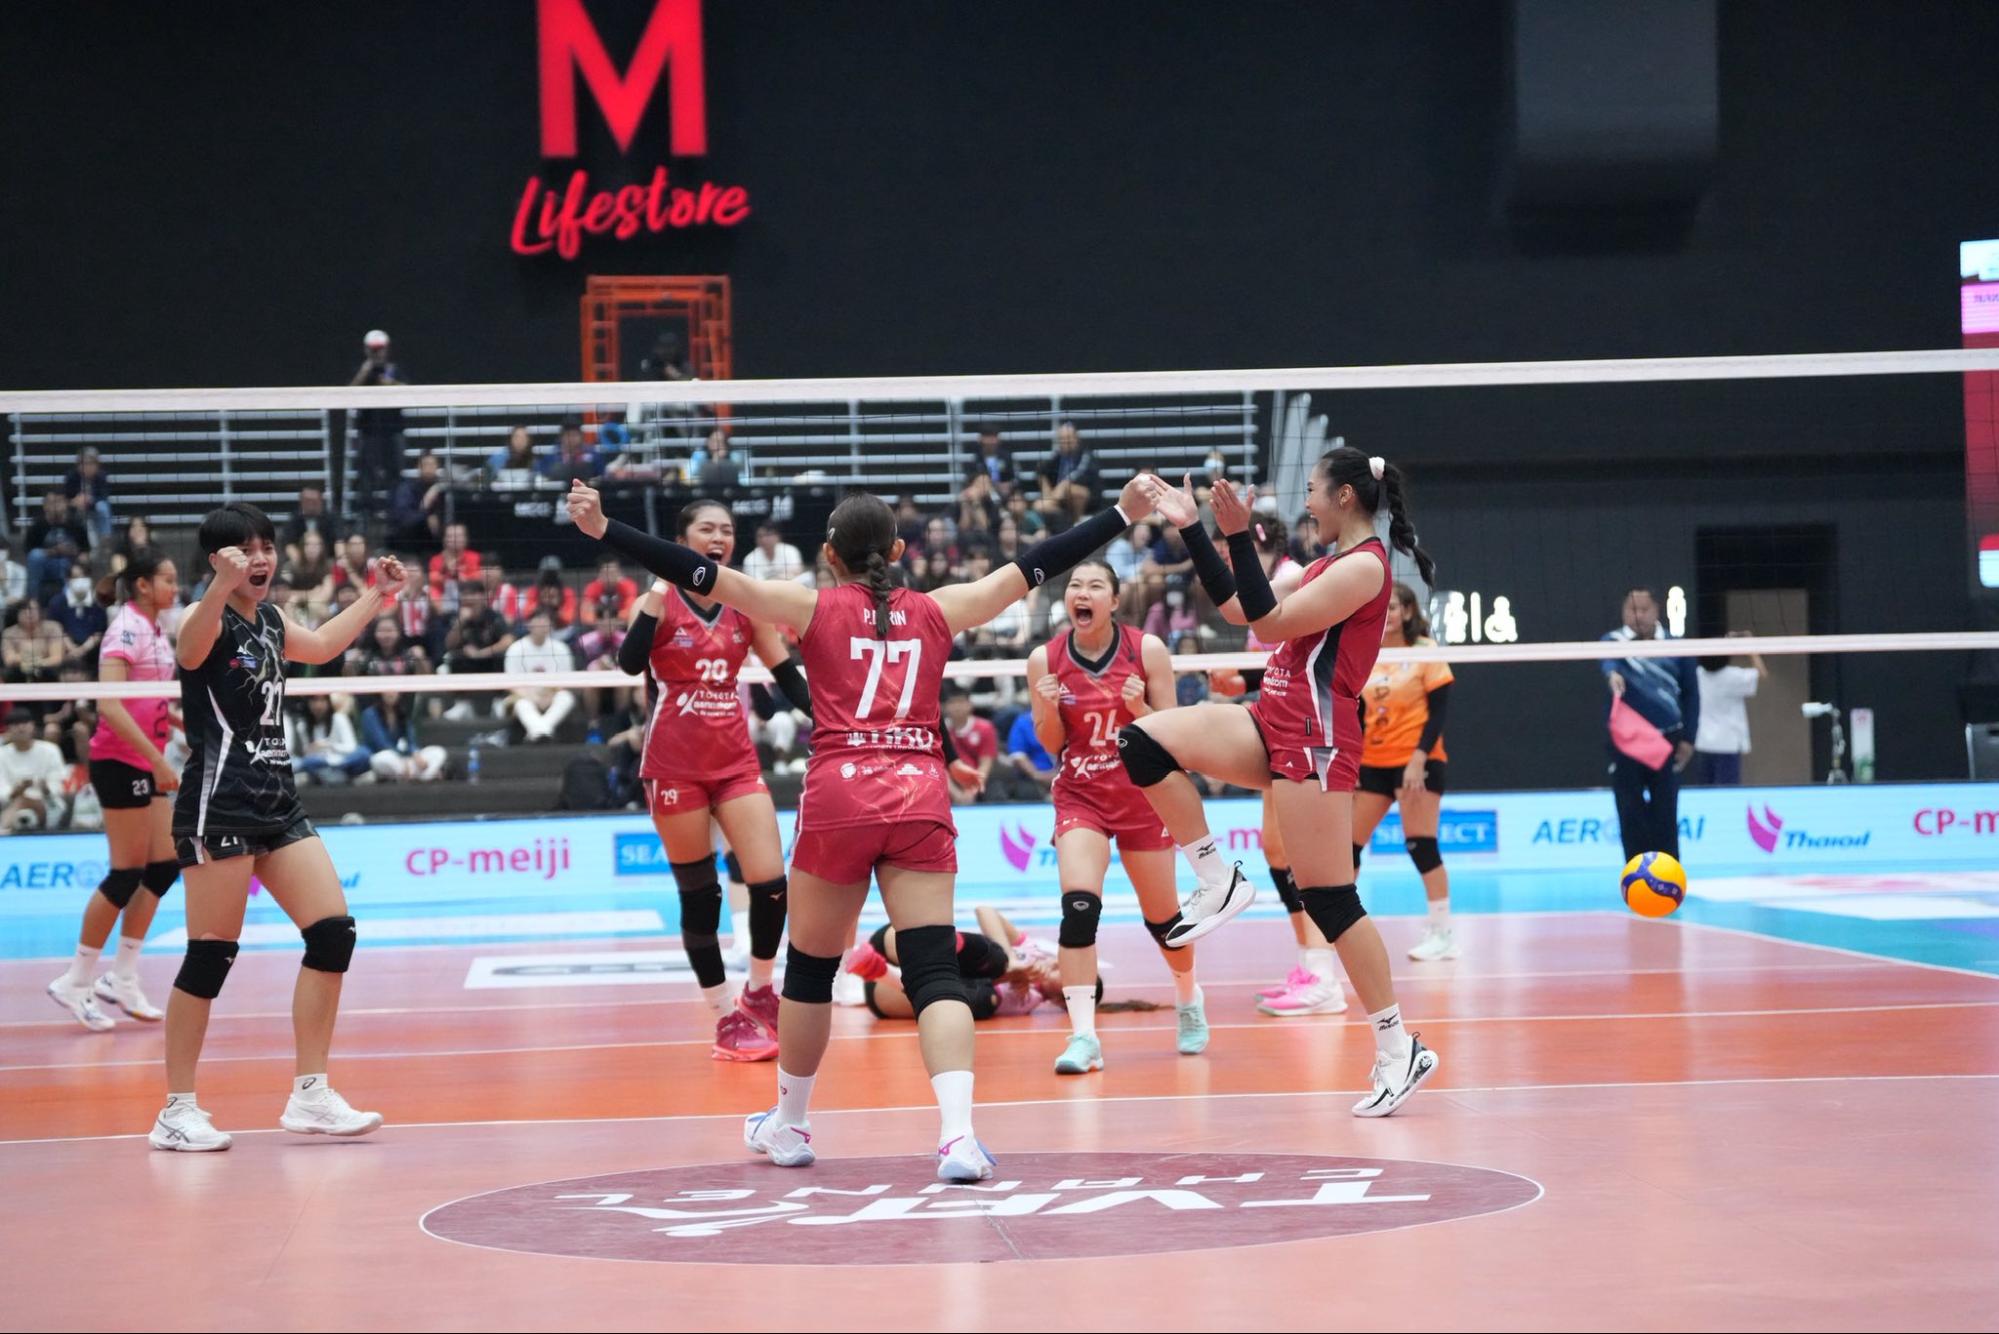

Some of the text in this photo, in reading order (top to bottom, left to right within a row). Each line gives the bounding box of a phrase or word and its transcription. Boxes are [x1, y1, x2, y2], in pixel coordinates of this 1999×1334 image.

[536, 0, 707, 157] M
[510, 165, 750, 260] Lifestore
[850, 636, 921, 719] 77
[260, 681, 282, 726] 21
[1083, 709, 1121, 747] 24
[132, 779, 148, 796] 23
[660, 788, 678, 806] 29
[405, 837, 571, 881] CP-meiji
[552, 1167, 1383, 1207] CHANNEL
